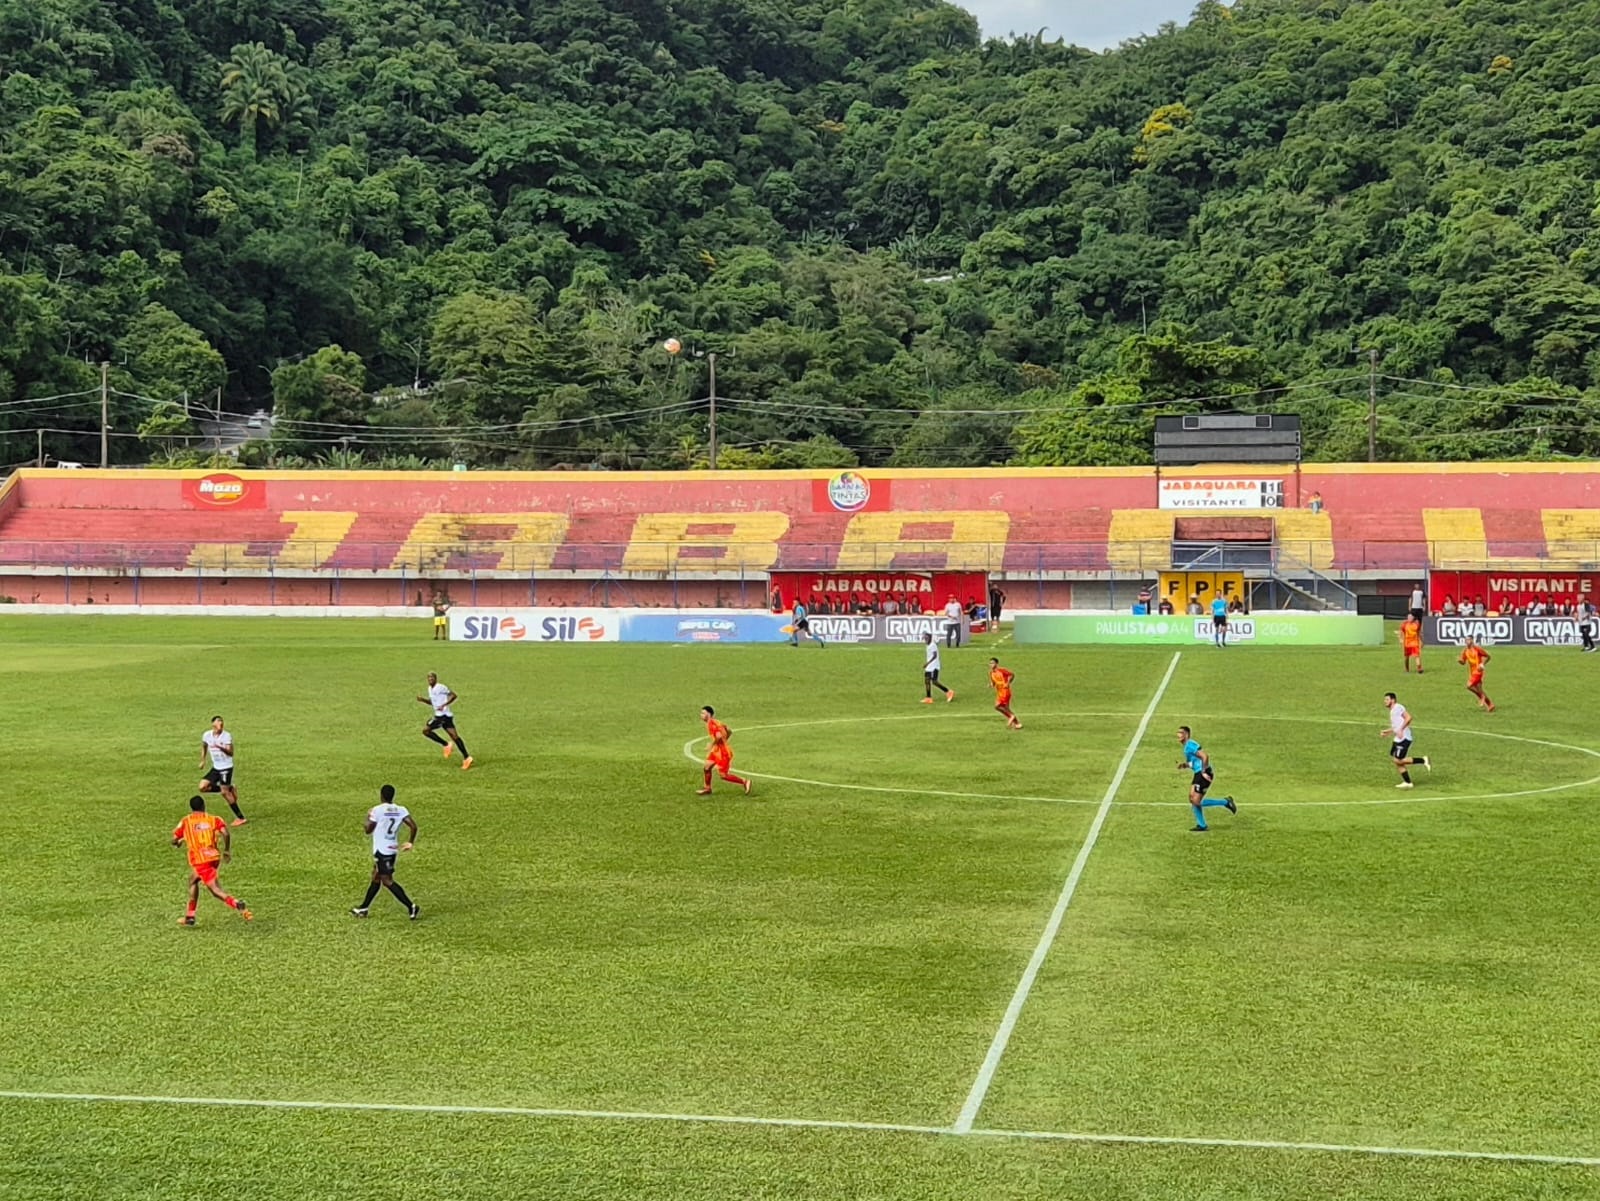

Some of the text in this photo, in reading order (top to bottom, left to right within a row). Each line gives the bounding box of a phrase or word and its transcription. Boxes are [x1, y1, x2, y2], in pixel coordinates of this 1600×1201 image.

[1162, 481, 1257, 490] JABAQUARA
[832, 491, 866, 500] TINTAS
[812, 579, 932, 592] JABAQUARA
[1490, 579, 1592, 592] VISITANTE
[463, 616, 498, 639] Sil
[540, 616, 576, 640] Sil
[808, 619, 872, 634] RIVALO
[1262, 622, 1299, 636] 2026
[1441, 621, 1509, 637] RIVALO
[387, 817, 396, 835] 2
